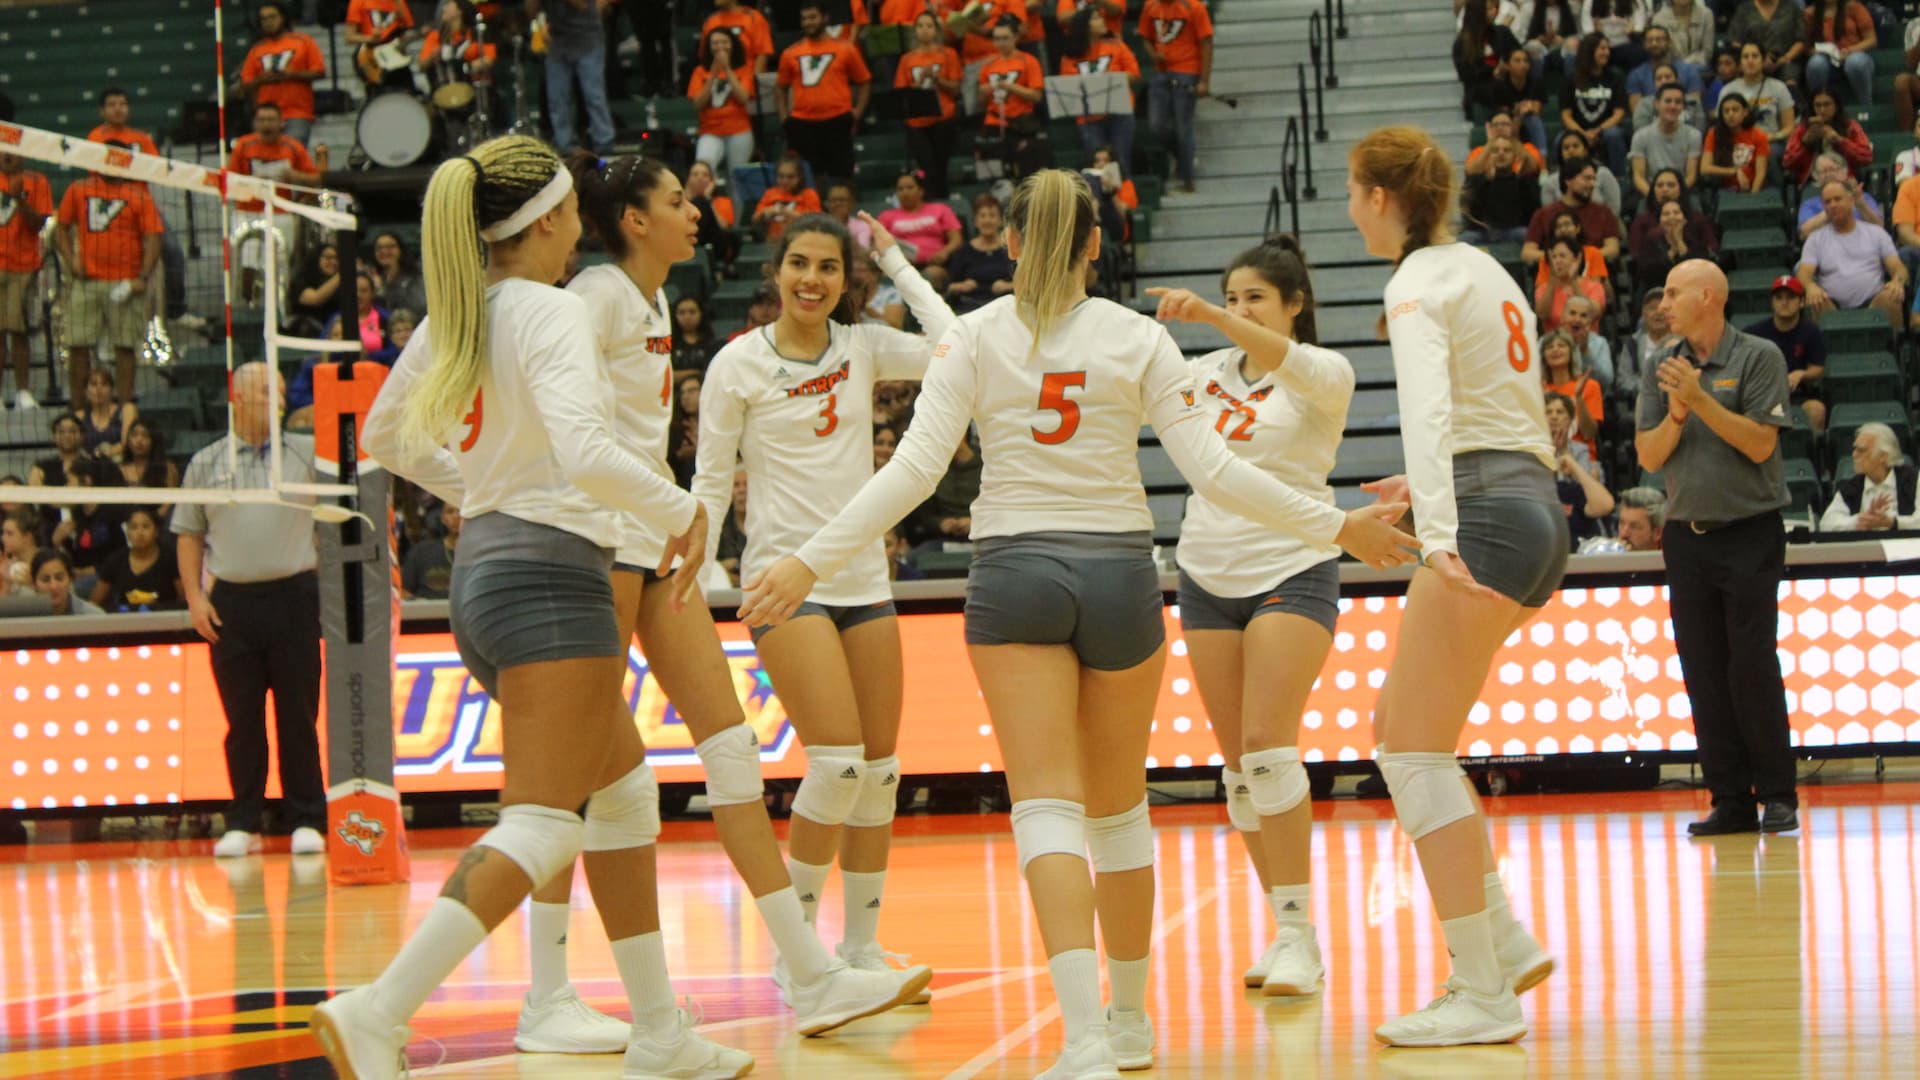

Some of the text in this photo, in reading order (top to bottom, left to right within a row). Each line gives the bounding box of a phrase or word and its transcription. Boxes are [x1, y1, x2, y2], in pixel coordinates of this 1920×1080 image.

[798, 52, 835, 88] V
[85, 195, 129, 233] V
[1502, 300, 1530, 373] 8
[813, 393, 839, 438] 3
[1030, 370, 1087, 446] 5
[1214, 405, 1257, 443] 12
